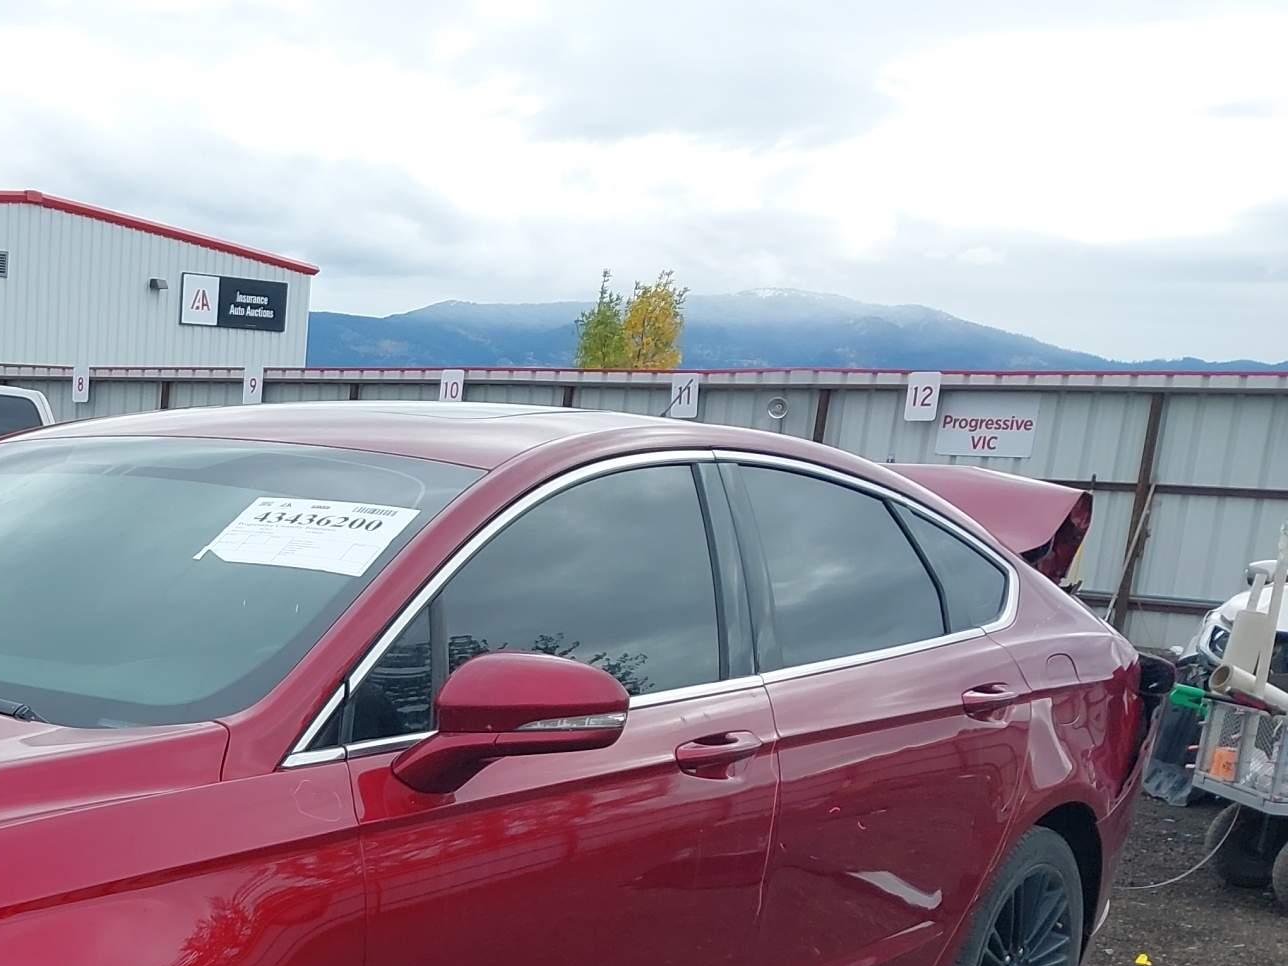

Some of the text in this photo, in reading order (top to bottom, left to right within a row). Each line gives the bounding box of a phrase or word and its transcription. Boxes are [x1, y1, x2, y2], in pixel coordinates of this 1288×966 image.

[236, 291, 269, 305] Insurance
[229, 303, 274, 318] Auto Auctions
[77, 377, 84, 392] 8
[249, 378, 257, 393] 9
[443, 381, 459, 399] 10
[678, 386, 691, 405] 11
[912, 386, 934, 407] 12
[942, 414, 1034, 432] Progressive
[971, 436, 998, 450] VIC
[253, 511, 383, 532] 43436200
